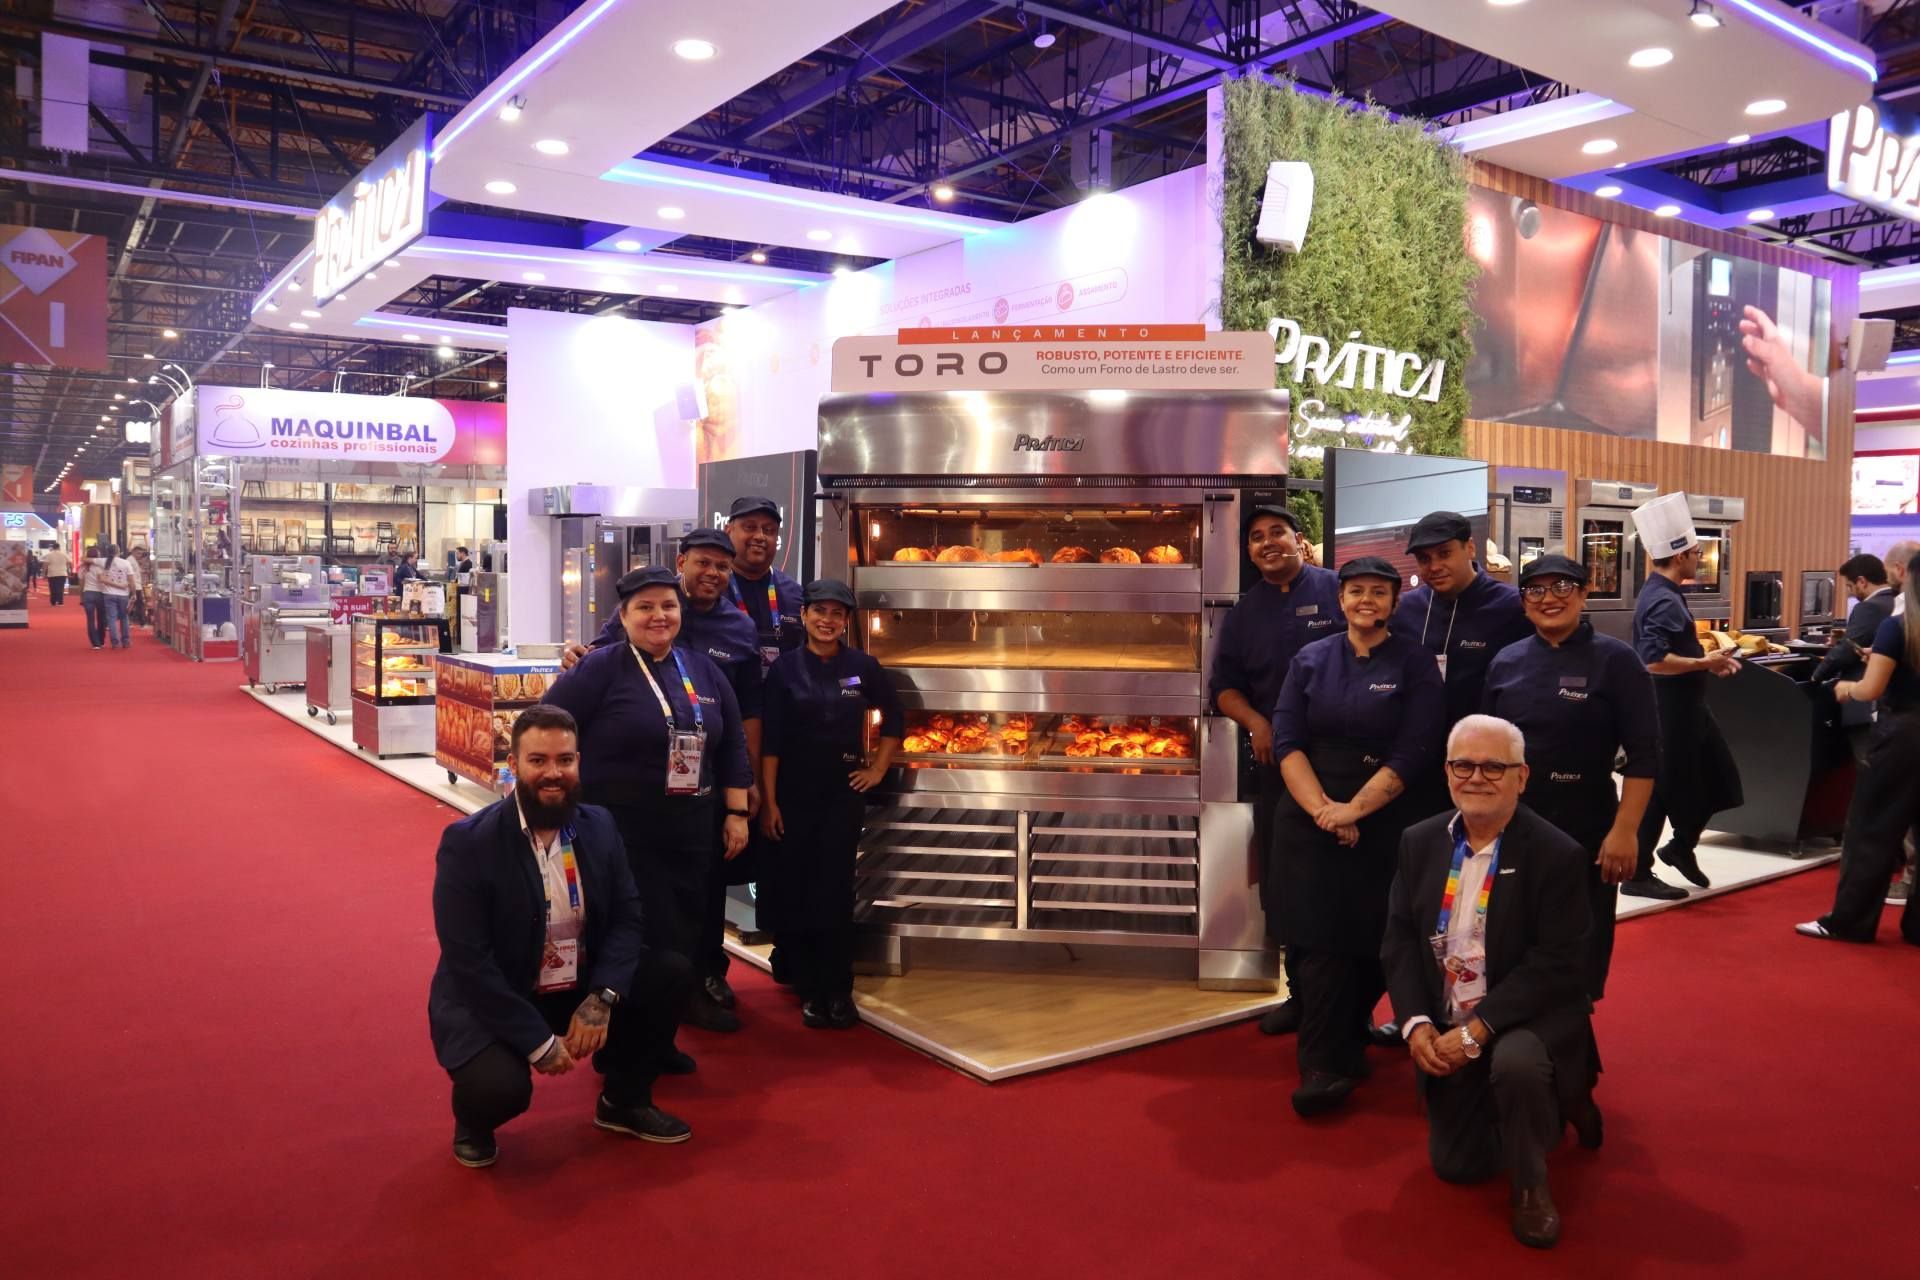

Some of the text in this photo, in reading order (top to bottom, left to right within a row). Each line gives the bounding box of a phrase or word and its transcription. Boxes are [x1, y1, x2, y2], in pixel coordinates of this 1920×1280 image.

[10, 251, 64, 268] FIPAN
[920, 282, 972, 304] INTEGRADAS
[952, 328, 1150, 340] LANÇAMENTO
[1036, 350, 1100, 362] ROBUSTO,
[1103, 350, 1162, 360] POTENTE
[1165, 350, 1172, 360] E
[1268, 318, 1446, 402] PRÁTICA
[859, 352, 1008, 378] TORO
[1042, 364, 1240, 374] Como um Forno de Lastro deve ser.
[271, 418, 438, 442] MAQUINBAL
[270, 438, 438, 454] cozinhas profissionais
